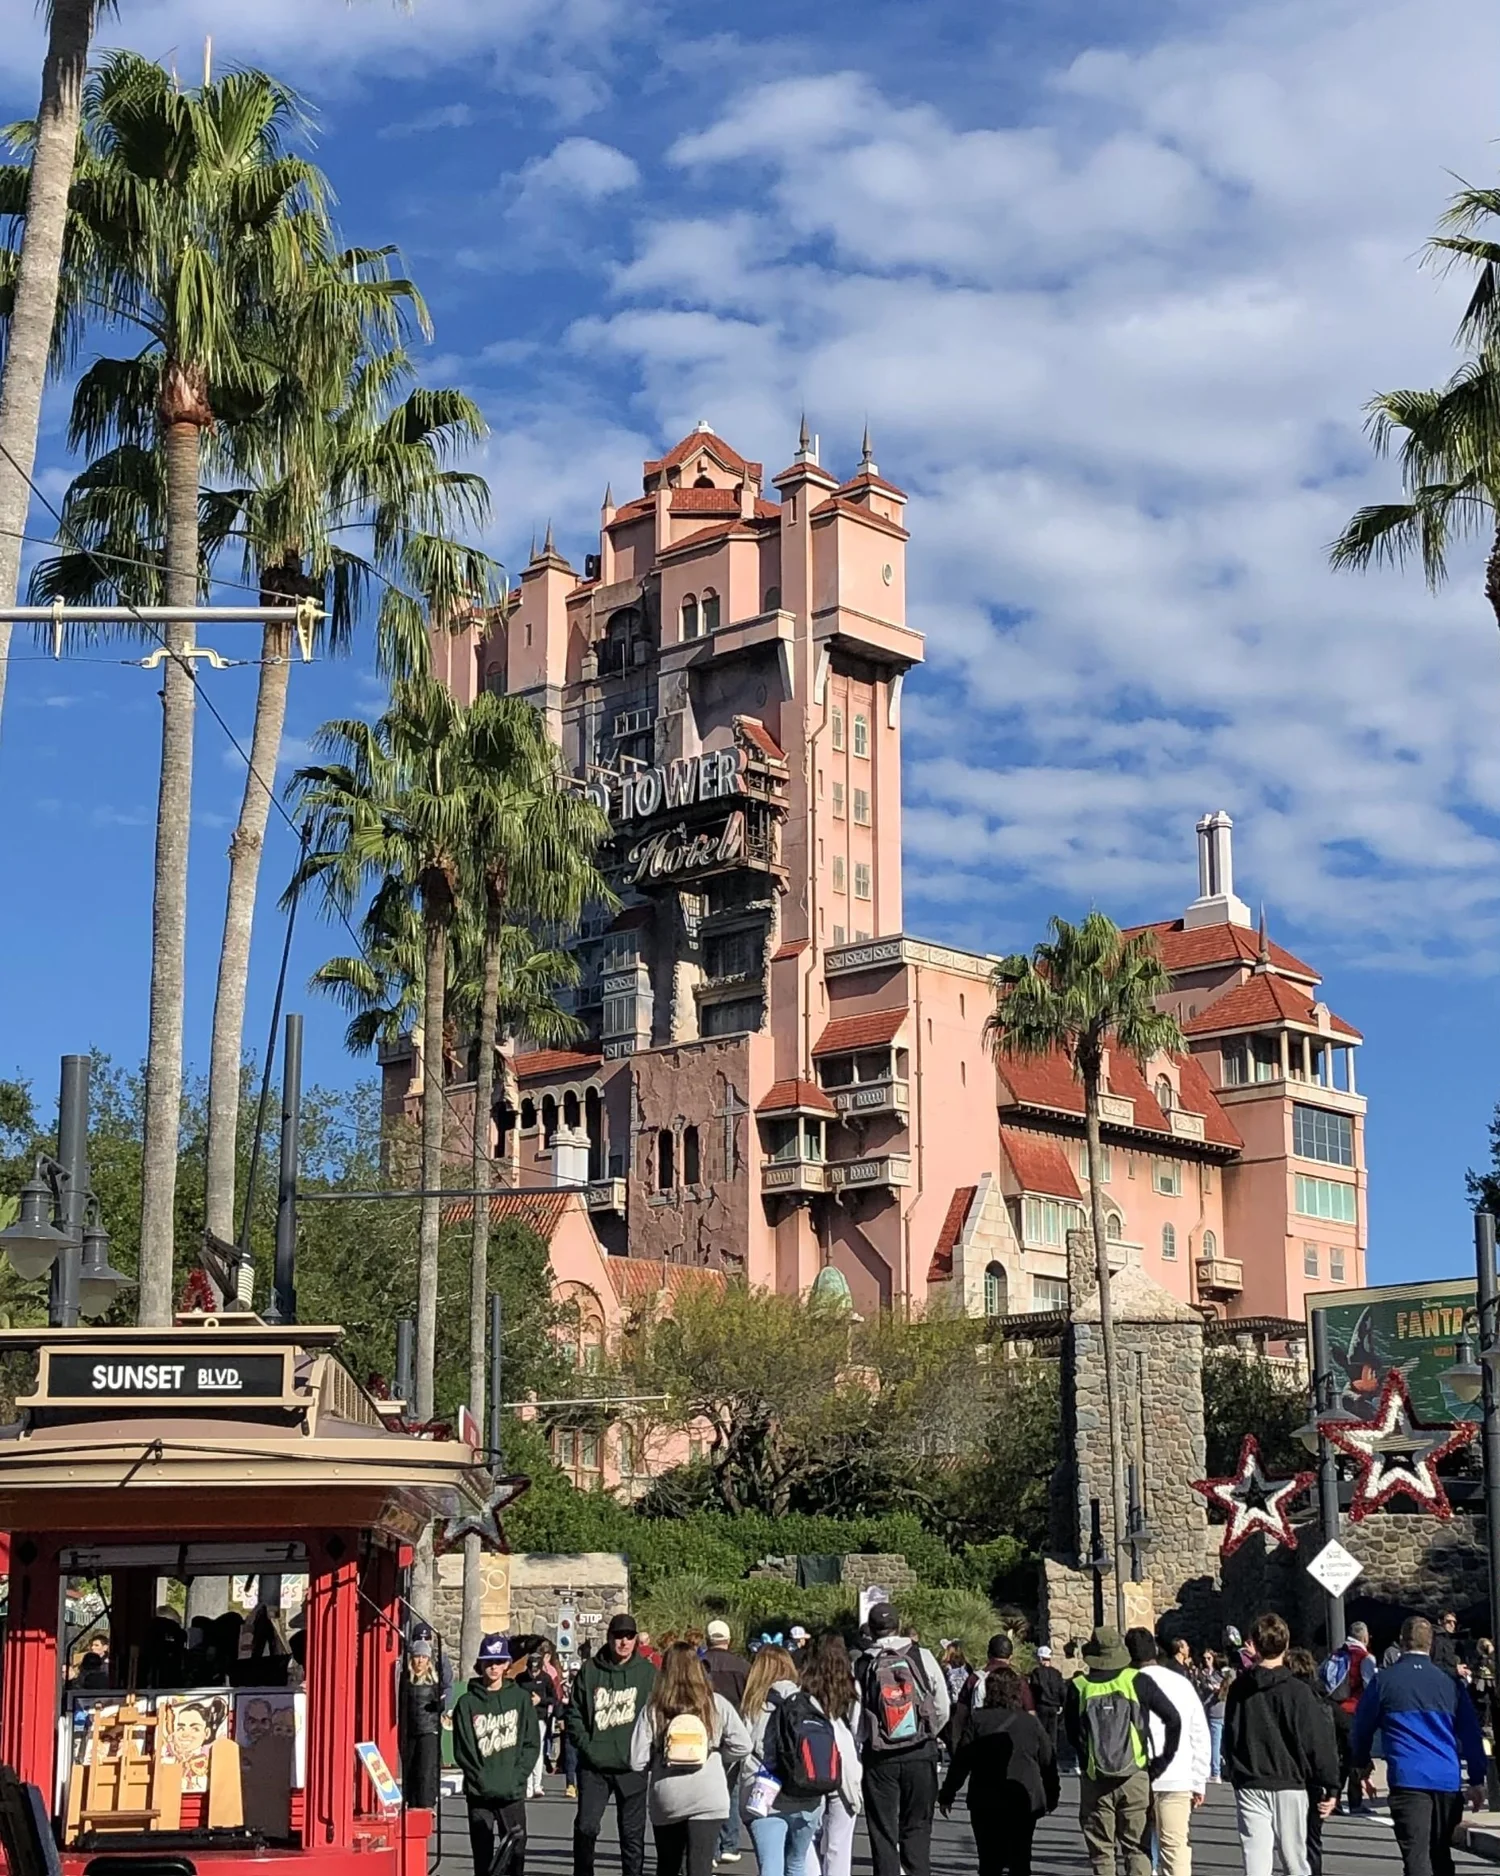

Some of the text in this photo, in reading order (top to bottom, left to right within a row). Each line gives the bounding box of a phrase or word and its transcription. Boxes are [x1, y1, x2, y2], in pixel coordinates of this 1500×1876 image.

[620, 747, 748, 820] TOWER
[92, 1365, 243, 1389] SUNSET BLVD.
[579, 1613, 602, 1624] STOP
[595, 1687, 638, 1711] Disney
[473, 1709, 519, 1738] Disney
[595, 1704, 636, 1731] World
[478, 1725, 518, 1758] World
